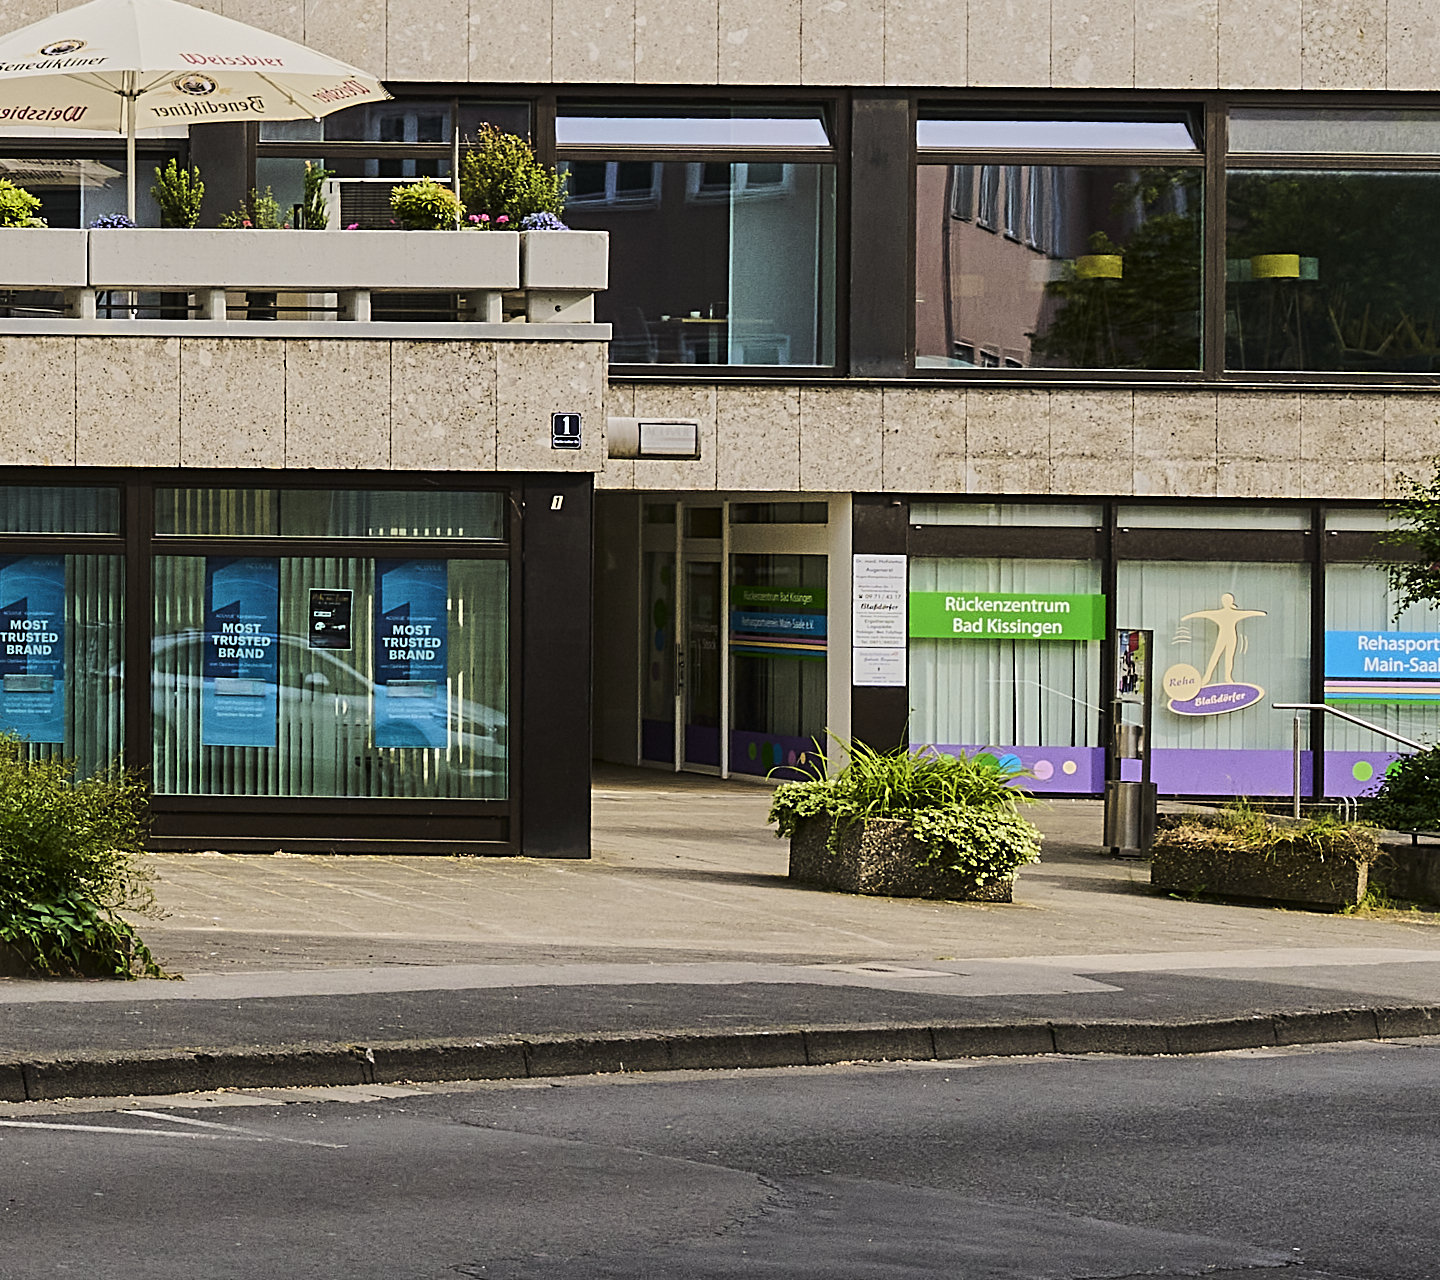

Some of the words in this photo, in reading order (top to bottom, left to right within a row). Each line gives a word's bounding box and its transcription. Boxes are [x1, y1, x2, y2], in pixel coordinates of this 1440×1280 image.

[179, 52, 285, 67] Weissbier
[562, 415, 571, 435] 1
[945, 596, 1070, 613] Rückenzentrum
[10, 620, 49, 631] MOST
[222, 623, 261, 634] MOST
[392, 625, 432, 636] MOST
[953, 618, 982, 633] Bad
[987, 618, 1063, 637] Kissingen
[0, 632, 59, 643] TRUSTED
[212, 635, 271, 647] TRUSTED
[382, 637, 442, 648] TRUSTED
[6, 644, 52, 655] BRAND
[218, 648, 265, 659] BRAND
[389, 650, 435, 661] BRAND
[1169, 676, 1196, 687] Reha
[1194, 690, 1246, 707] Blaßdörfer
